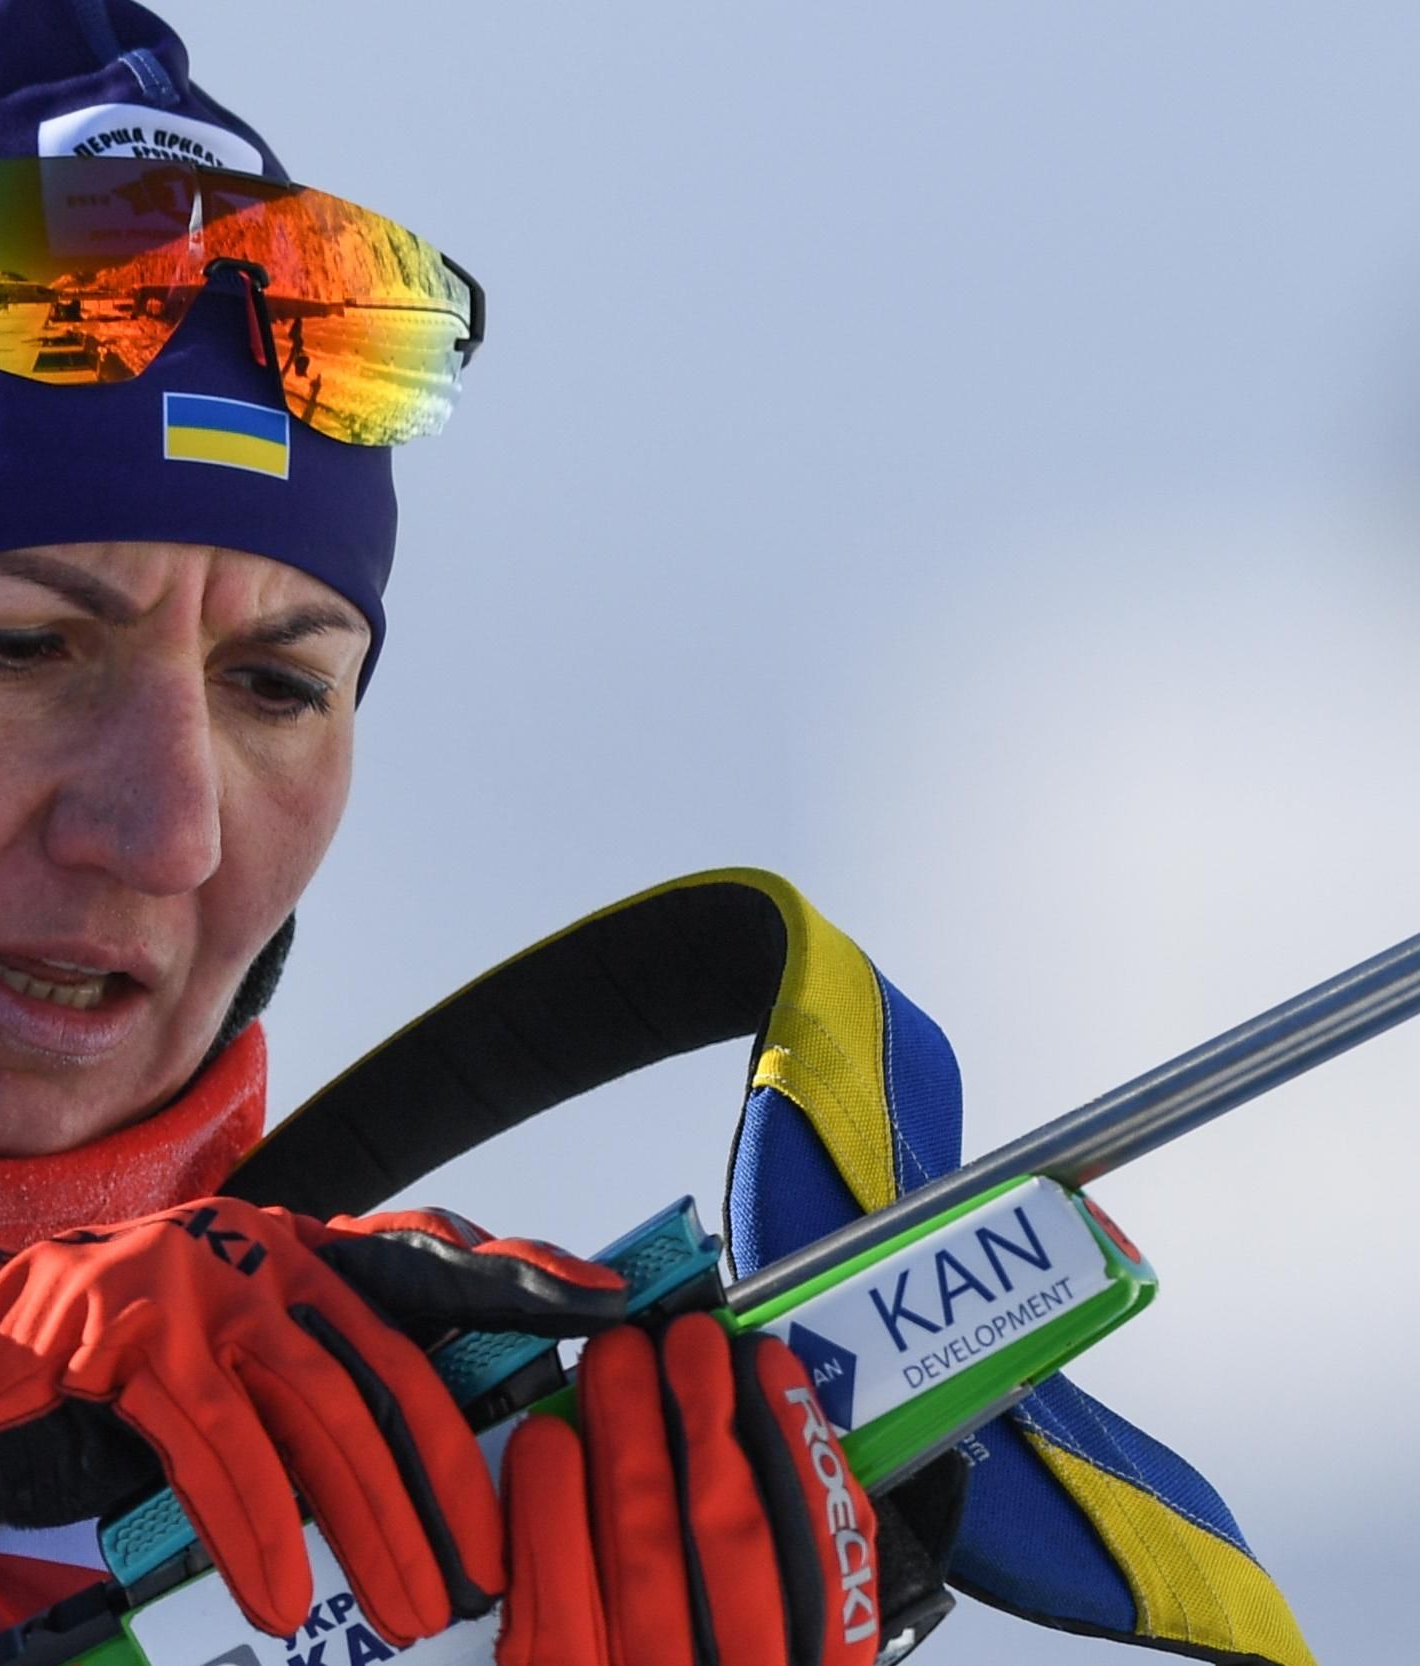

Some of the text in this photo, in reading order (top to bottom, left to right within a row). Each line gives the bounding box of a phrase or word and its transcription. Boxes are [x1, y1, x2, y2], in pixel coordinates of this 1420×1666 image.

[868, 1206, 1053, 1352] KAN
[902, 1277, 1075, 1389] DEVELOPMENT
[804, 1357, 844, 1388] AN
